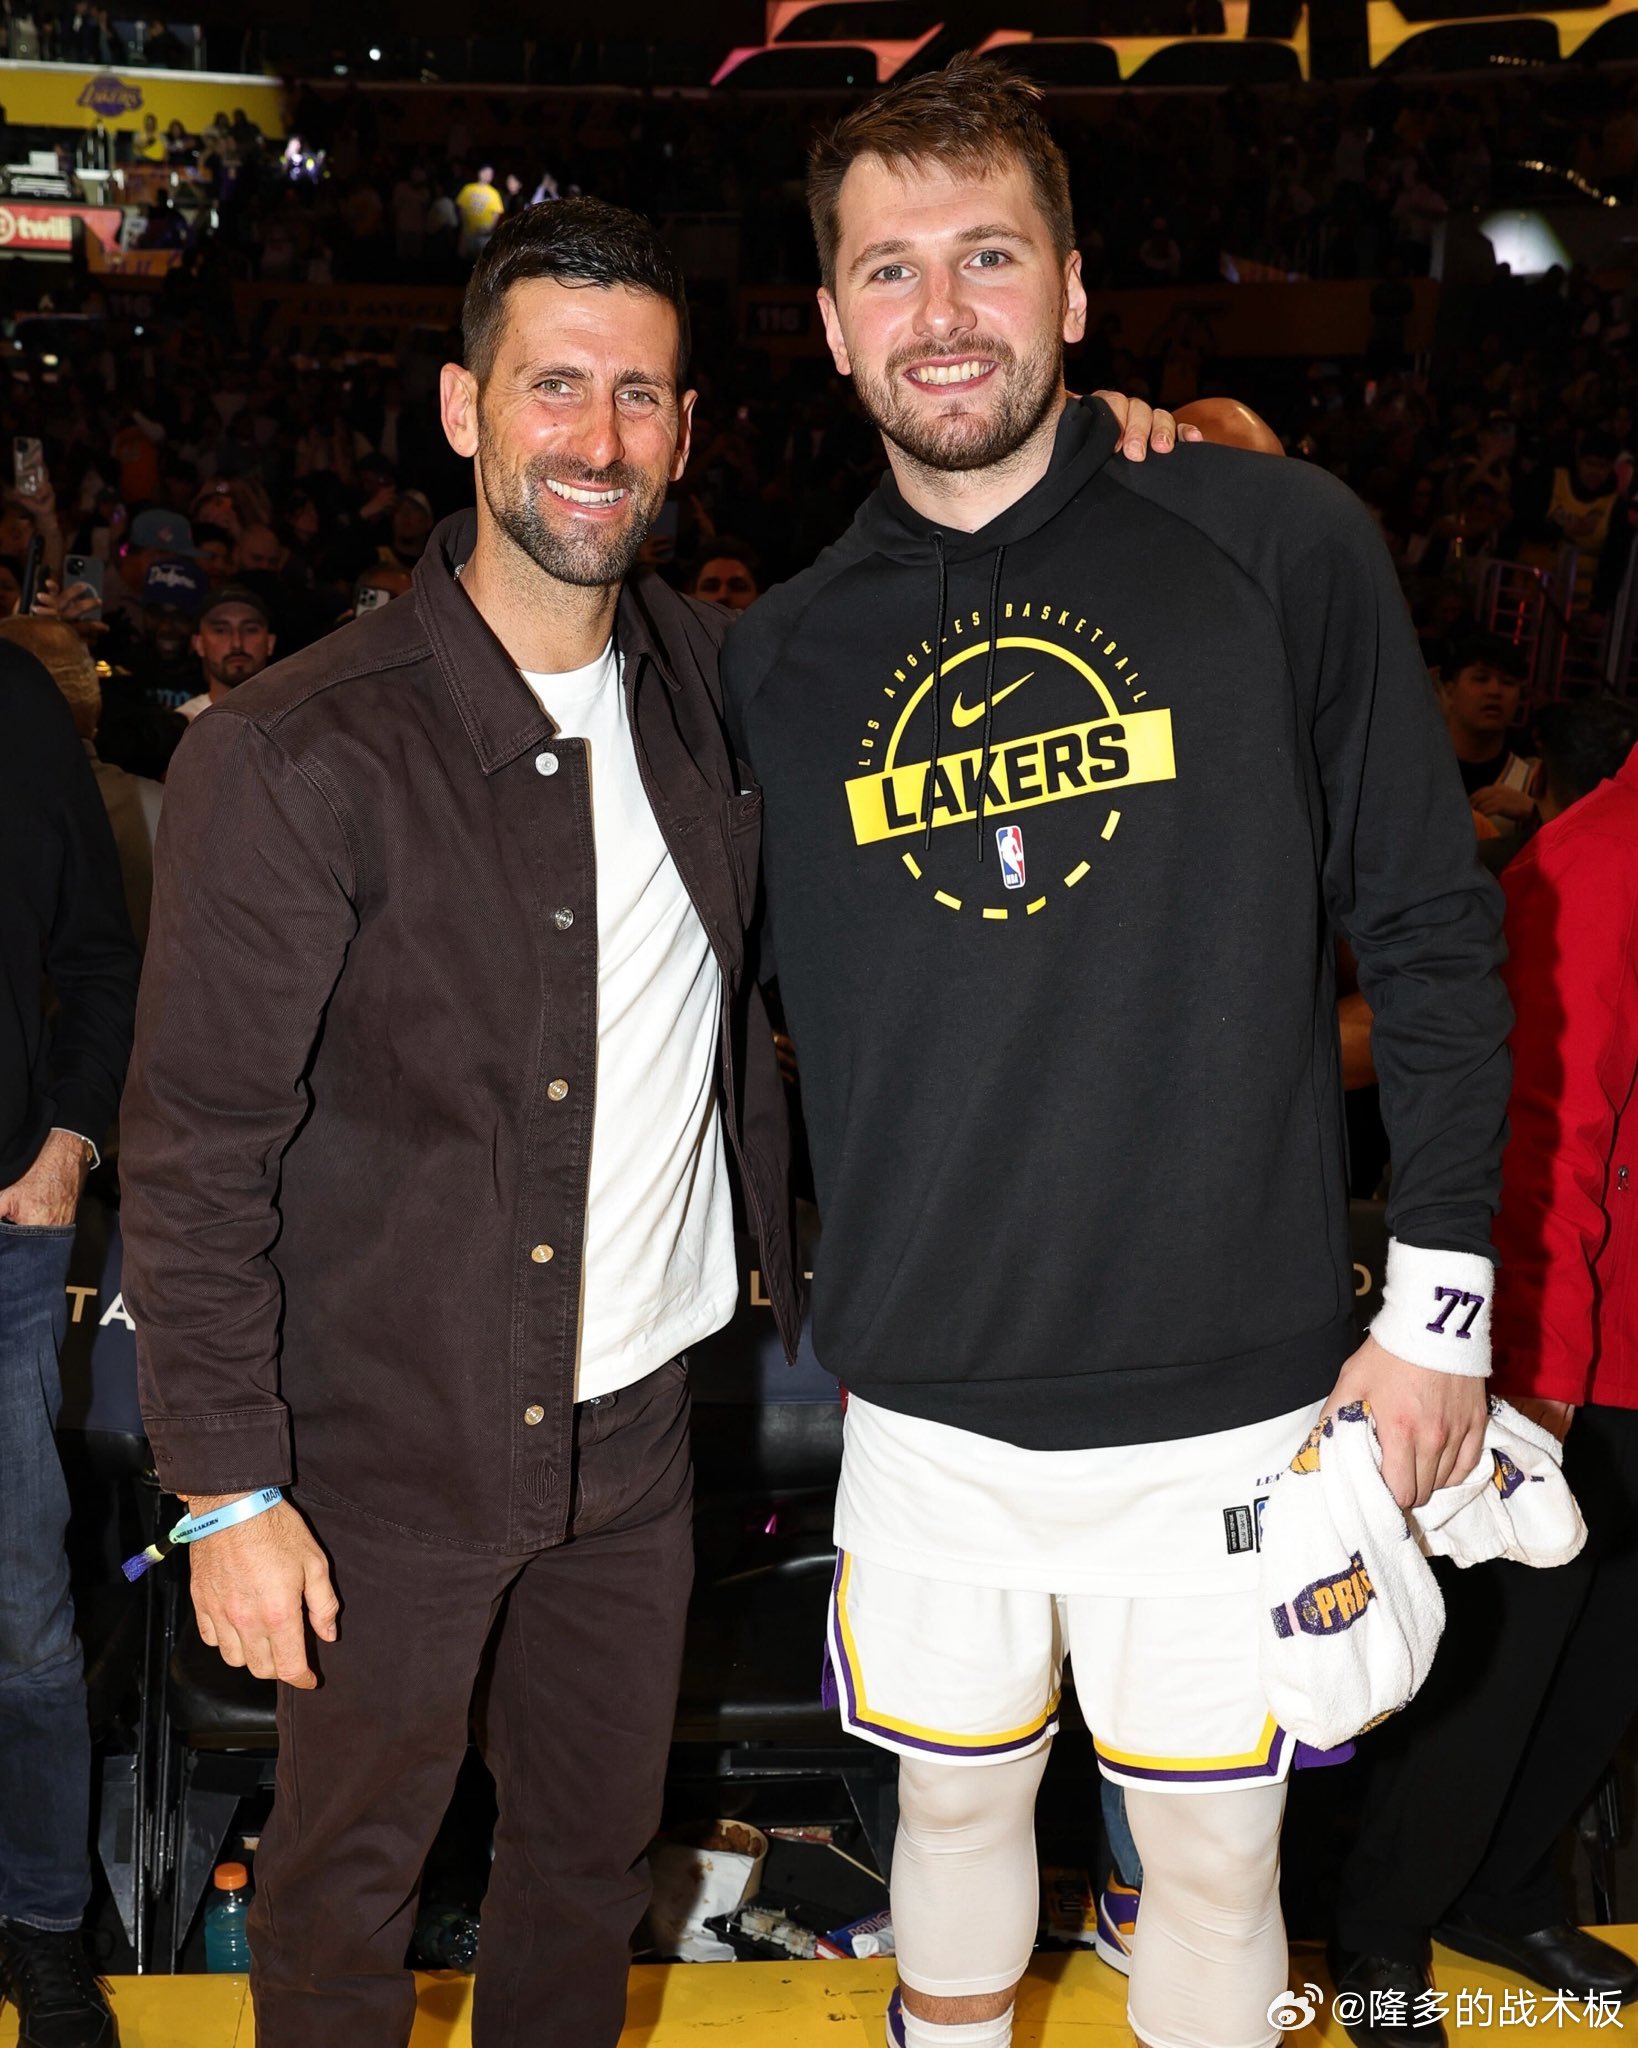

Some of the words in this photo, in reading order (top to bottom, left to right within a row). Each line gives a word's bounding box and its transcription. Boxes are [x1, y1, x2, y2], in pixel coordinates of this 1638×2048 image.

[18, 214, 71, 240] twili
[858, 719, 881, 767] LOS
[882, 612, 981, 700] ANGEES
[1005, 603, 1149, 704] BASKETBALL
[882, 723, 1129, 830] LAKERS
[1426, 1286, 1486, 1339] 77
[1256, 1471, 1285, 1487] LEA
